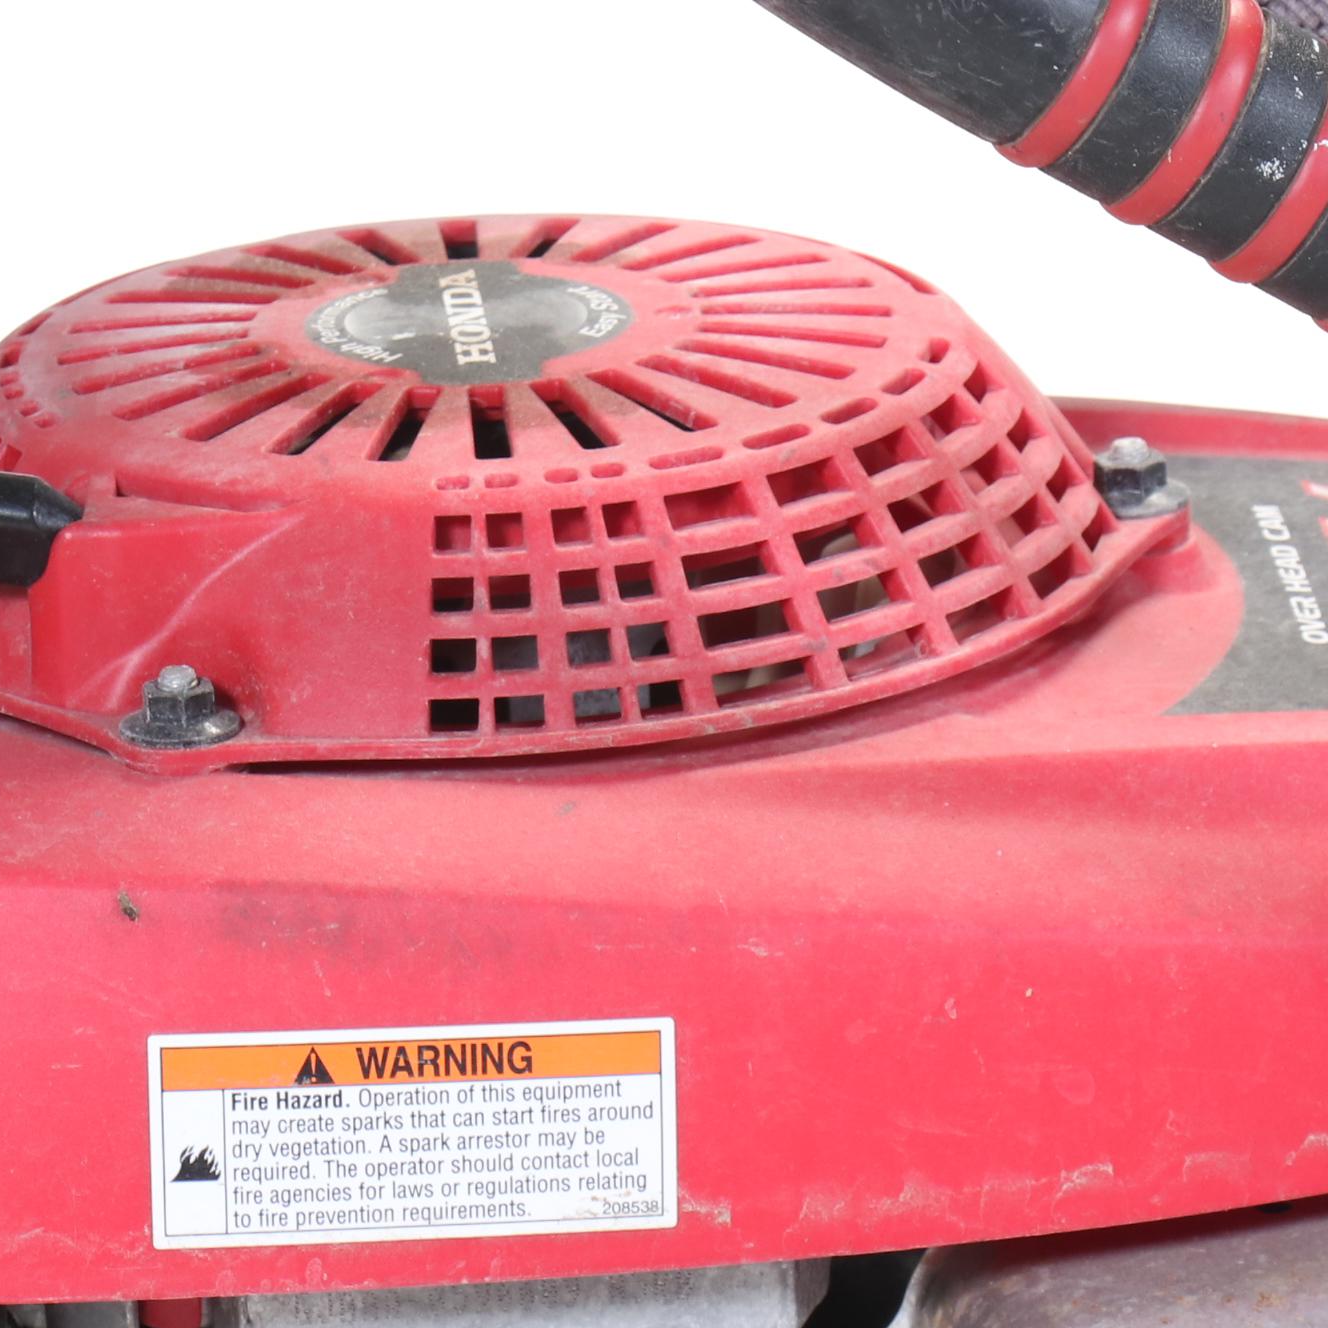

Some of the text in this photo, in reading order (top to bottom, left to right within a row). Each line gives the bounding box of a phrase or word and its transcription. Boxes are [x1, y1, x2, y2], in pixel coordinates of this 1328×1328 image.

[438, 269, 497, 366] HONDA
[565, 285, 628, 338] Easy Start
[340, 341, 404, 364] High
[1251, 504, 1291, 542] CAM
[1270, 543, 1312, 594] HEAD
[356, 1041, 534, 1080] WARNING
[231, 1080, 622, 1111] Fire Hazard. Operation of this equipment
[232, 1101, 654, 1138] may create sparks that can start fires around
[231, 1127, 605, 1162] dry vegetation. A spark arrestor may be
[233, 1149, 639, 1184] required. The operator should contact local
[232, 1173, 647, 1207] fire agencies for laws or regulations relating
[233, 1200, 534, 1231] to fire prevention requirements.
[602, 1199, 660, 1217] 208538
